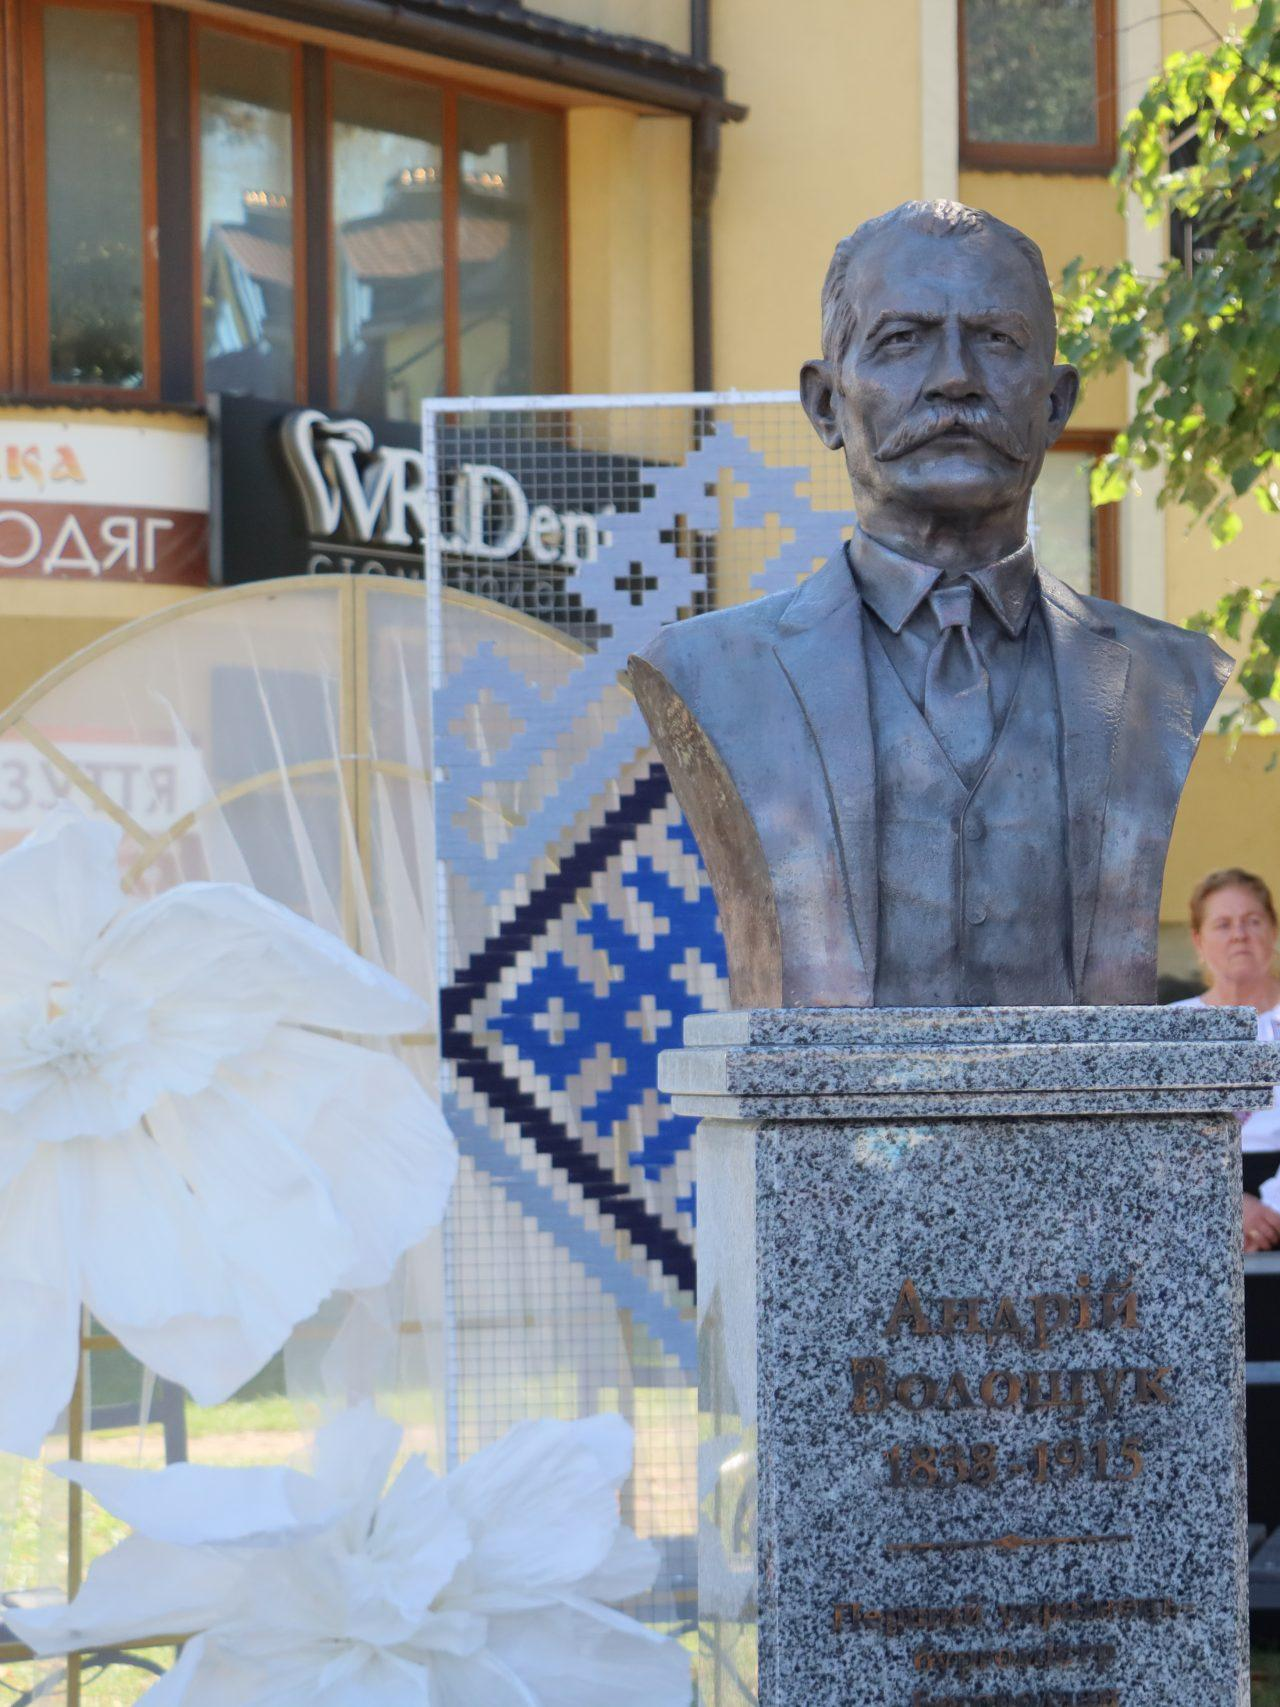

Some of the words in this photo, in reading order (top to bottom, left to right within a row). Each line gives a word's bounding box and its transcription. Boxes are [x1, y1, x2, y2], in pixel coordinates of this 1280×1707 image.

[0, 509, 174, 576] ОДЯГ
[884, 1272, 1140, 1350] Андрій
[851, 1356, 1173, 1424] Волощук
